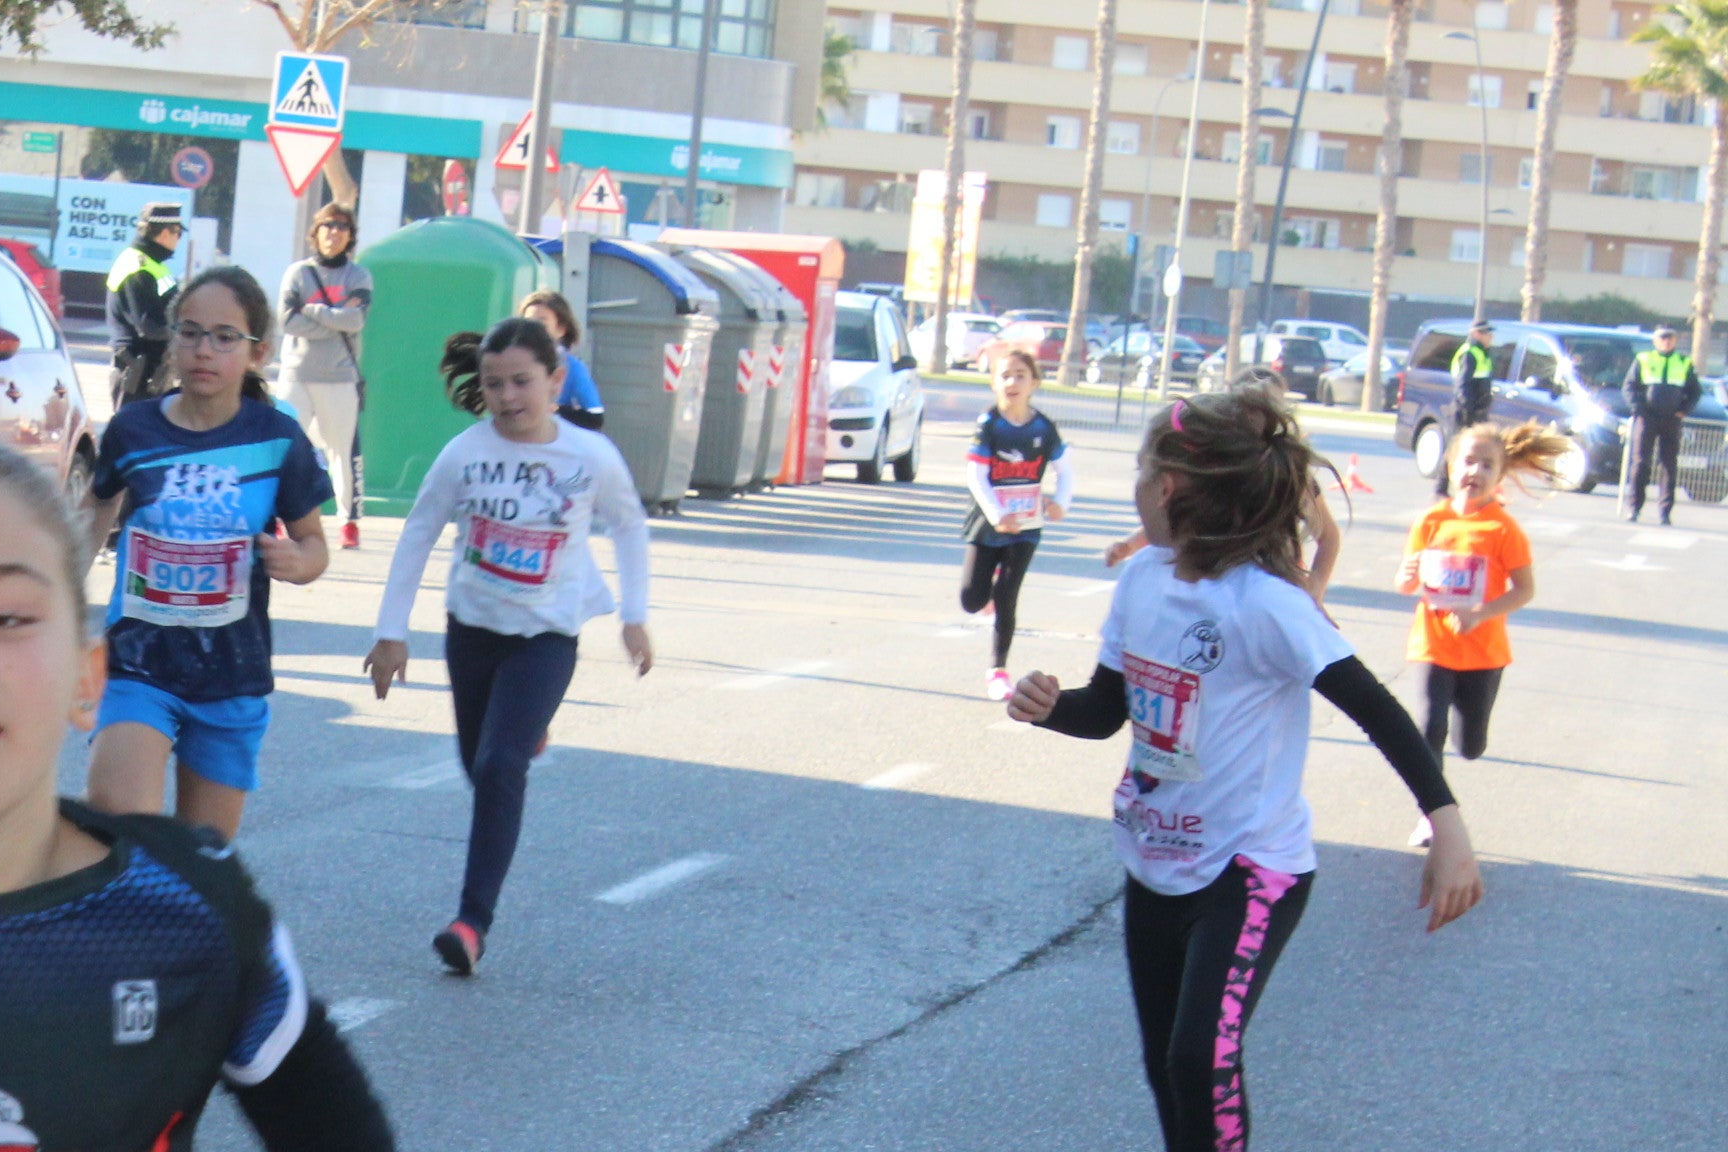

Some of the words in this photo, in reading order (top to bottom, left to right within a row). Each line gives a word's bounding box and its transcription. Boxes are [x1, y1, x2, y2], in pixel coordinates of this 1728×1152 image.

[170, 104, 252, 128] cajamar
[71, 196, 107, 210] CON
[491, 541, 542, 572] 944
[153, 562, 219, 593] 902
